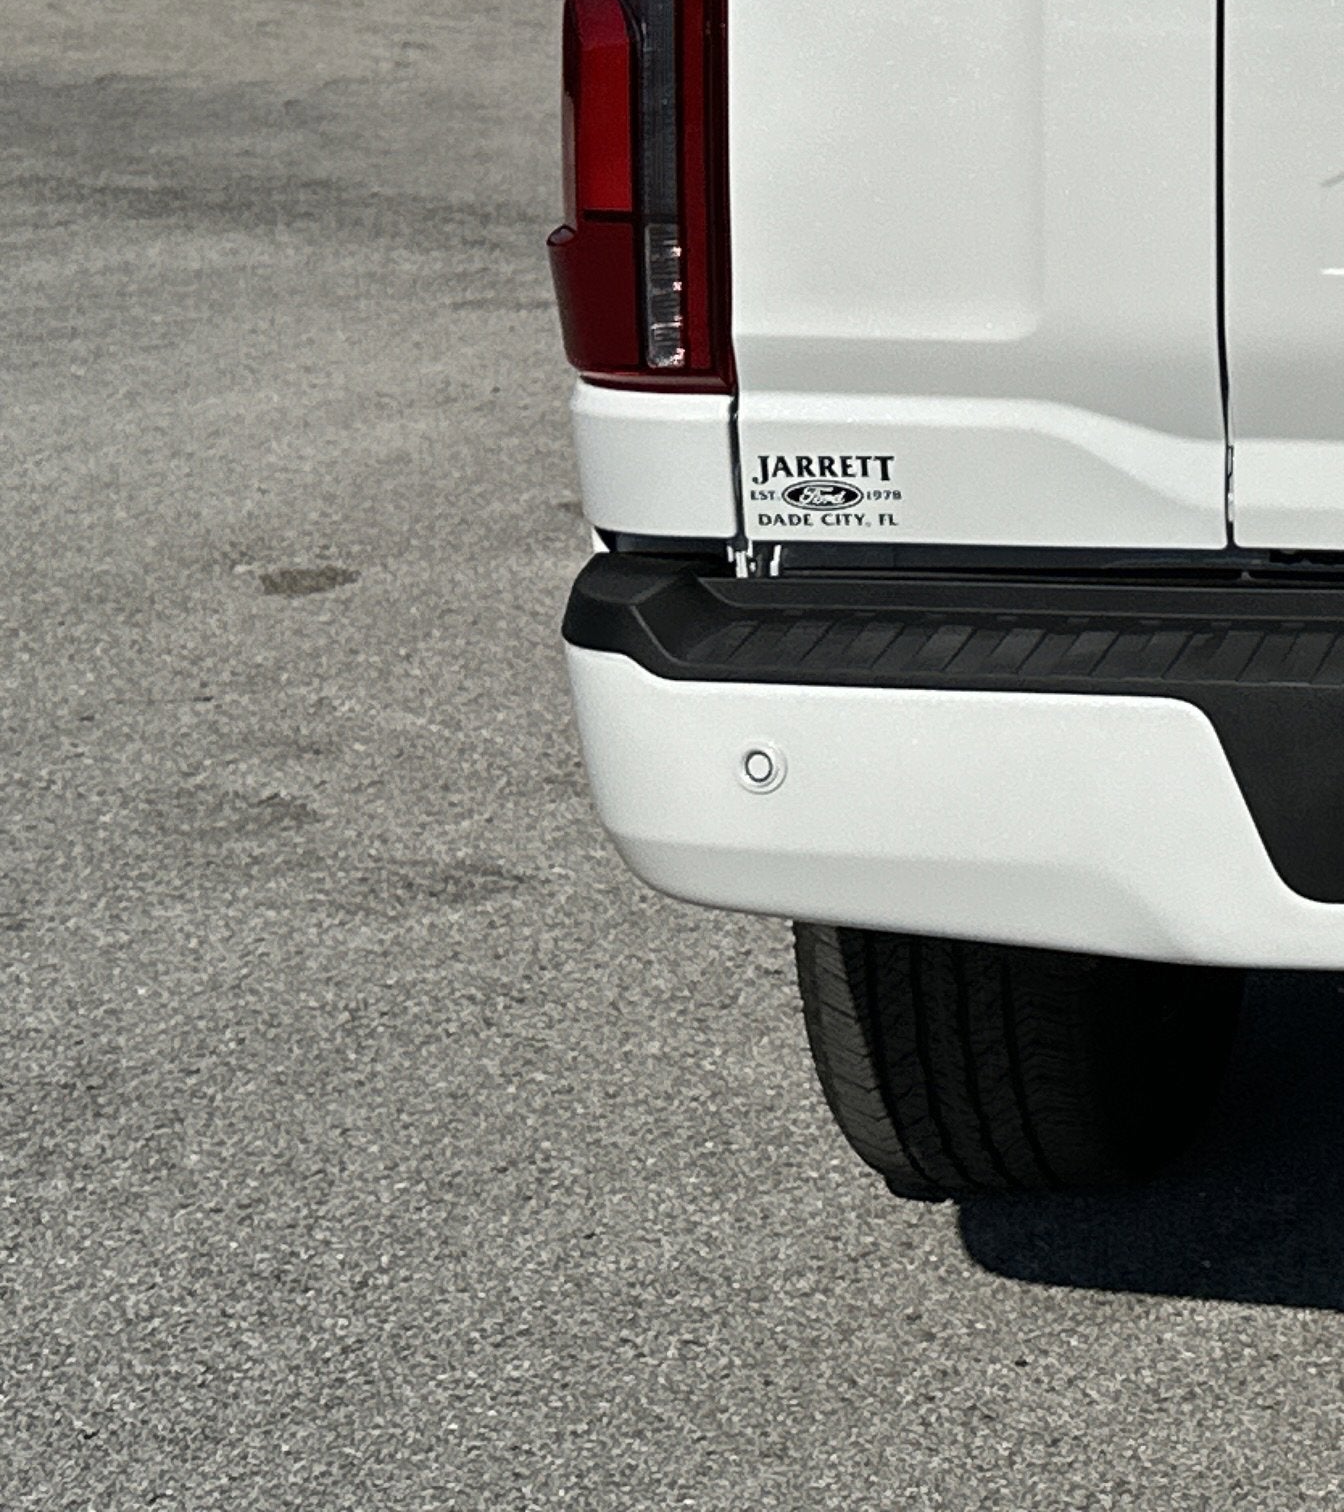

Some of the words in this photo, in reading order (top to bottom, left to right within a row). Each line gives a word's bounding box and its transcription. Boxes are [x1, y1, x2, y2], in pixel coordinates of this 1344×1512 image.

[752, 455, 895, 485] JARRETT
[799, 486, 847, 506] Ford
[866, 490, 902, 501] 1978
[758, 513, 813, 527] DADE
[878, 513, 898, 527] FL
